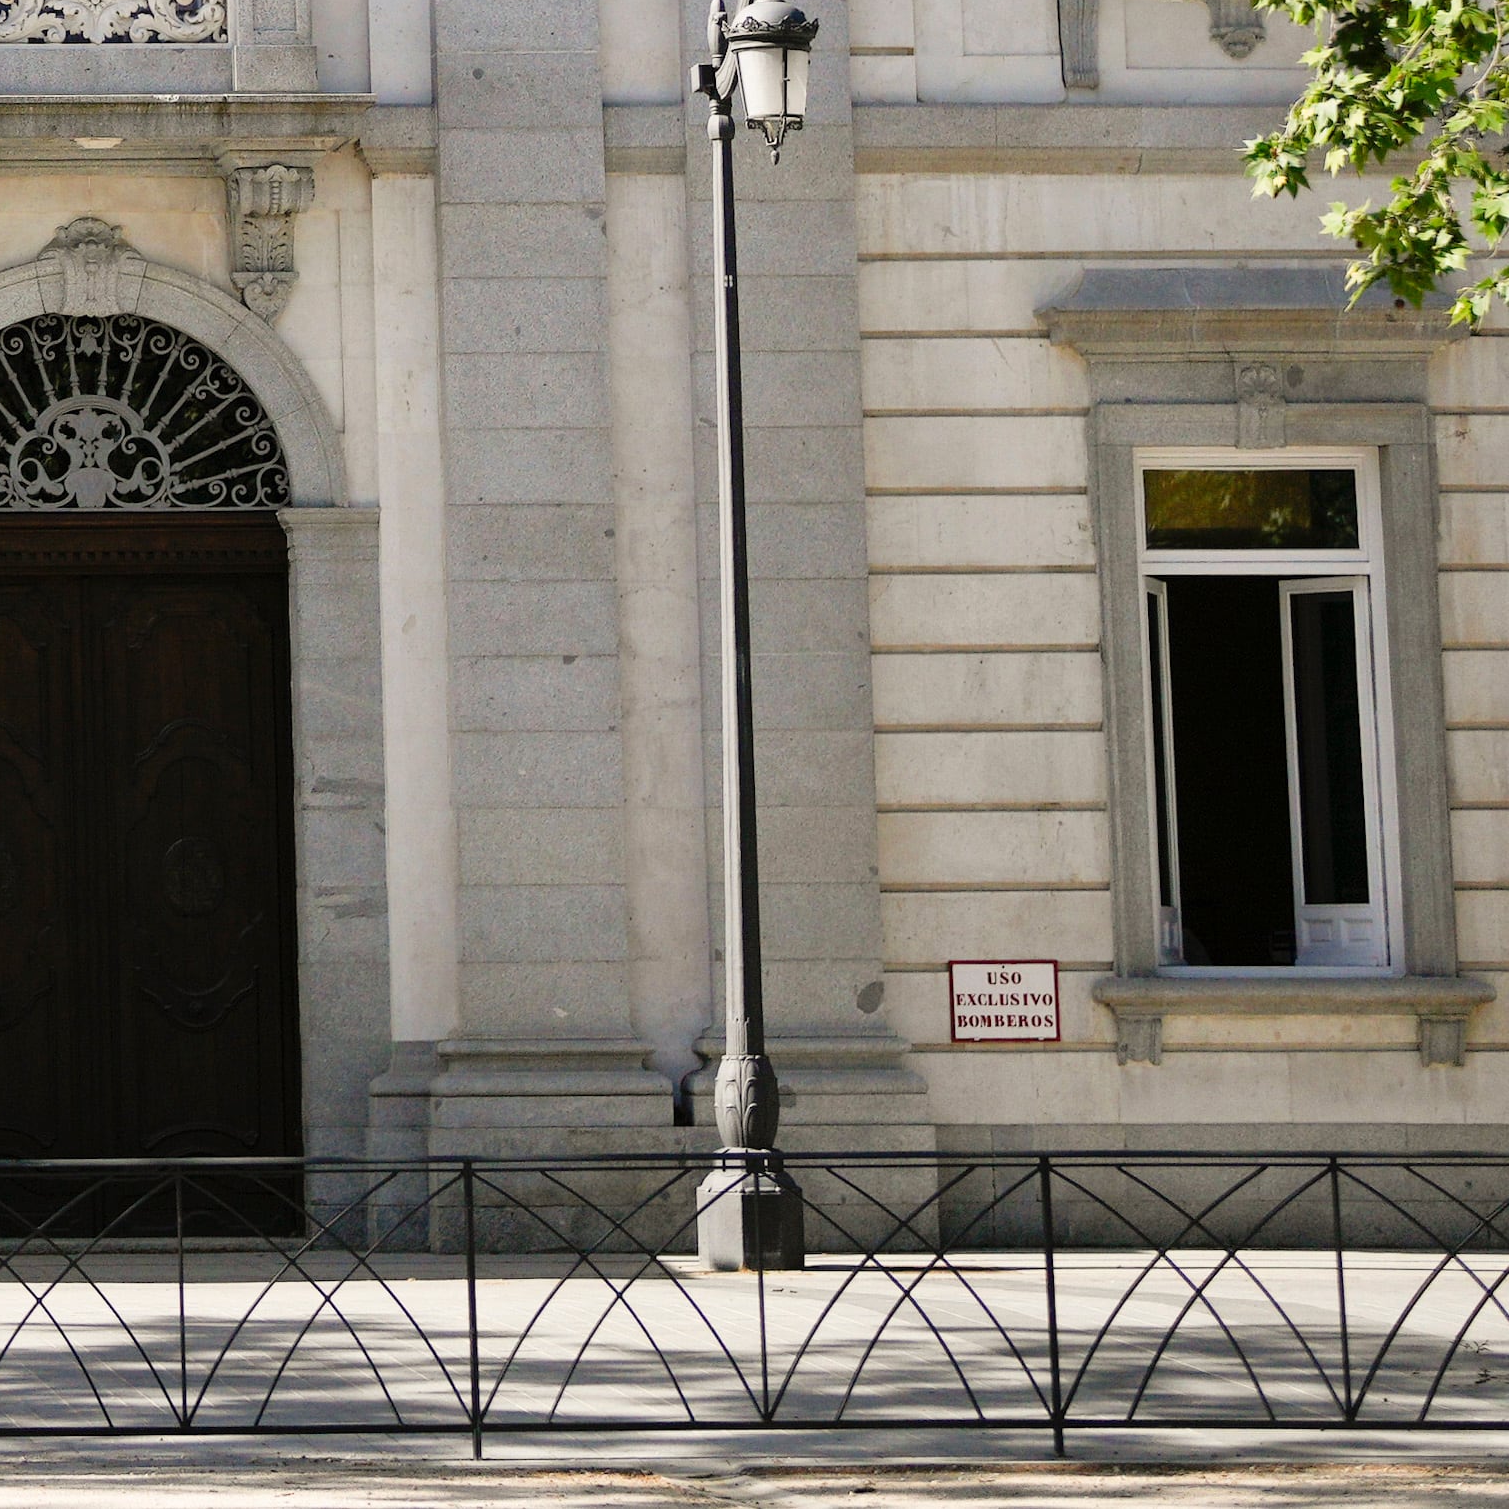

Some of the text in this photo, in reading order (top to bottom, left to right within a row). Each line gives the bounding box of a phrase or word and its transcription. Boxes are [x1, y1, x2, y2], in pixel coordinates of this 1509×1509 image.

[987, 971, 1022, 985] USO
[956, 993, 1053, 1006] EXCLUSIVO
[957, 1014, 1054, 1028] BOMBEROS
